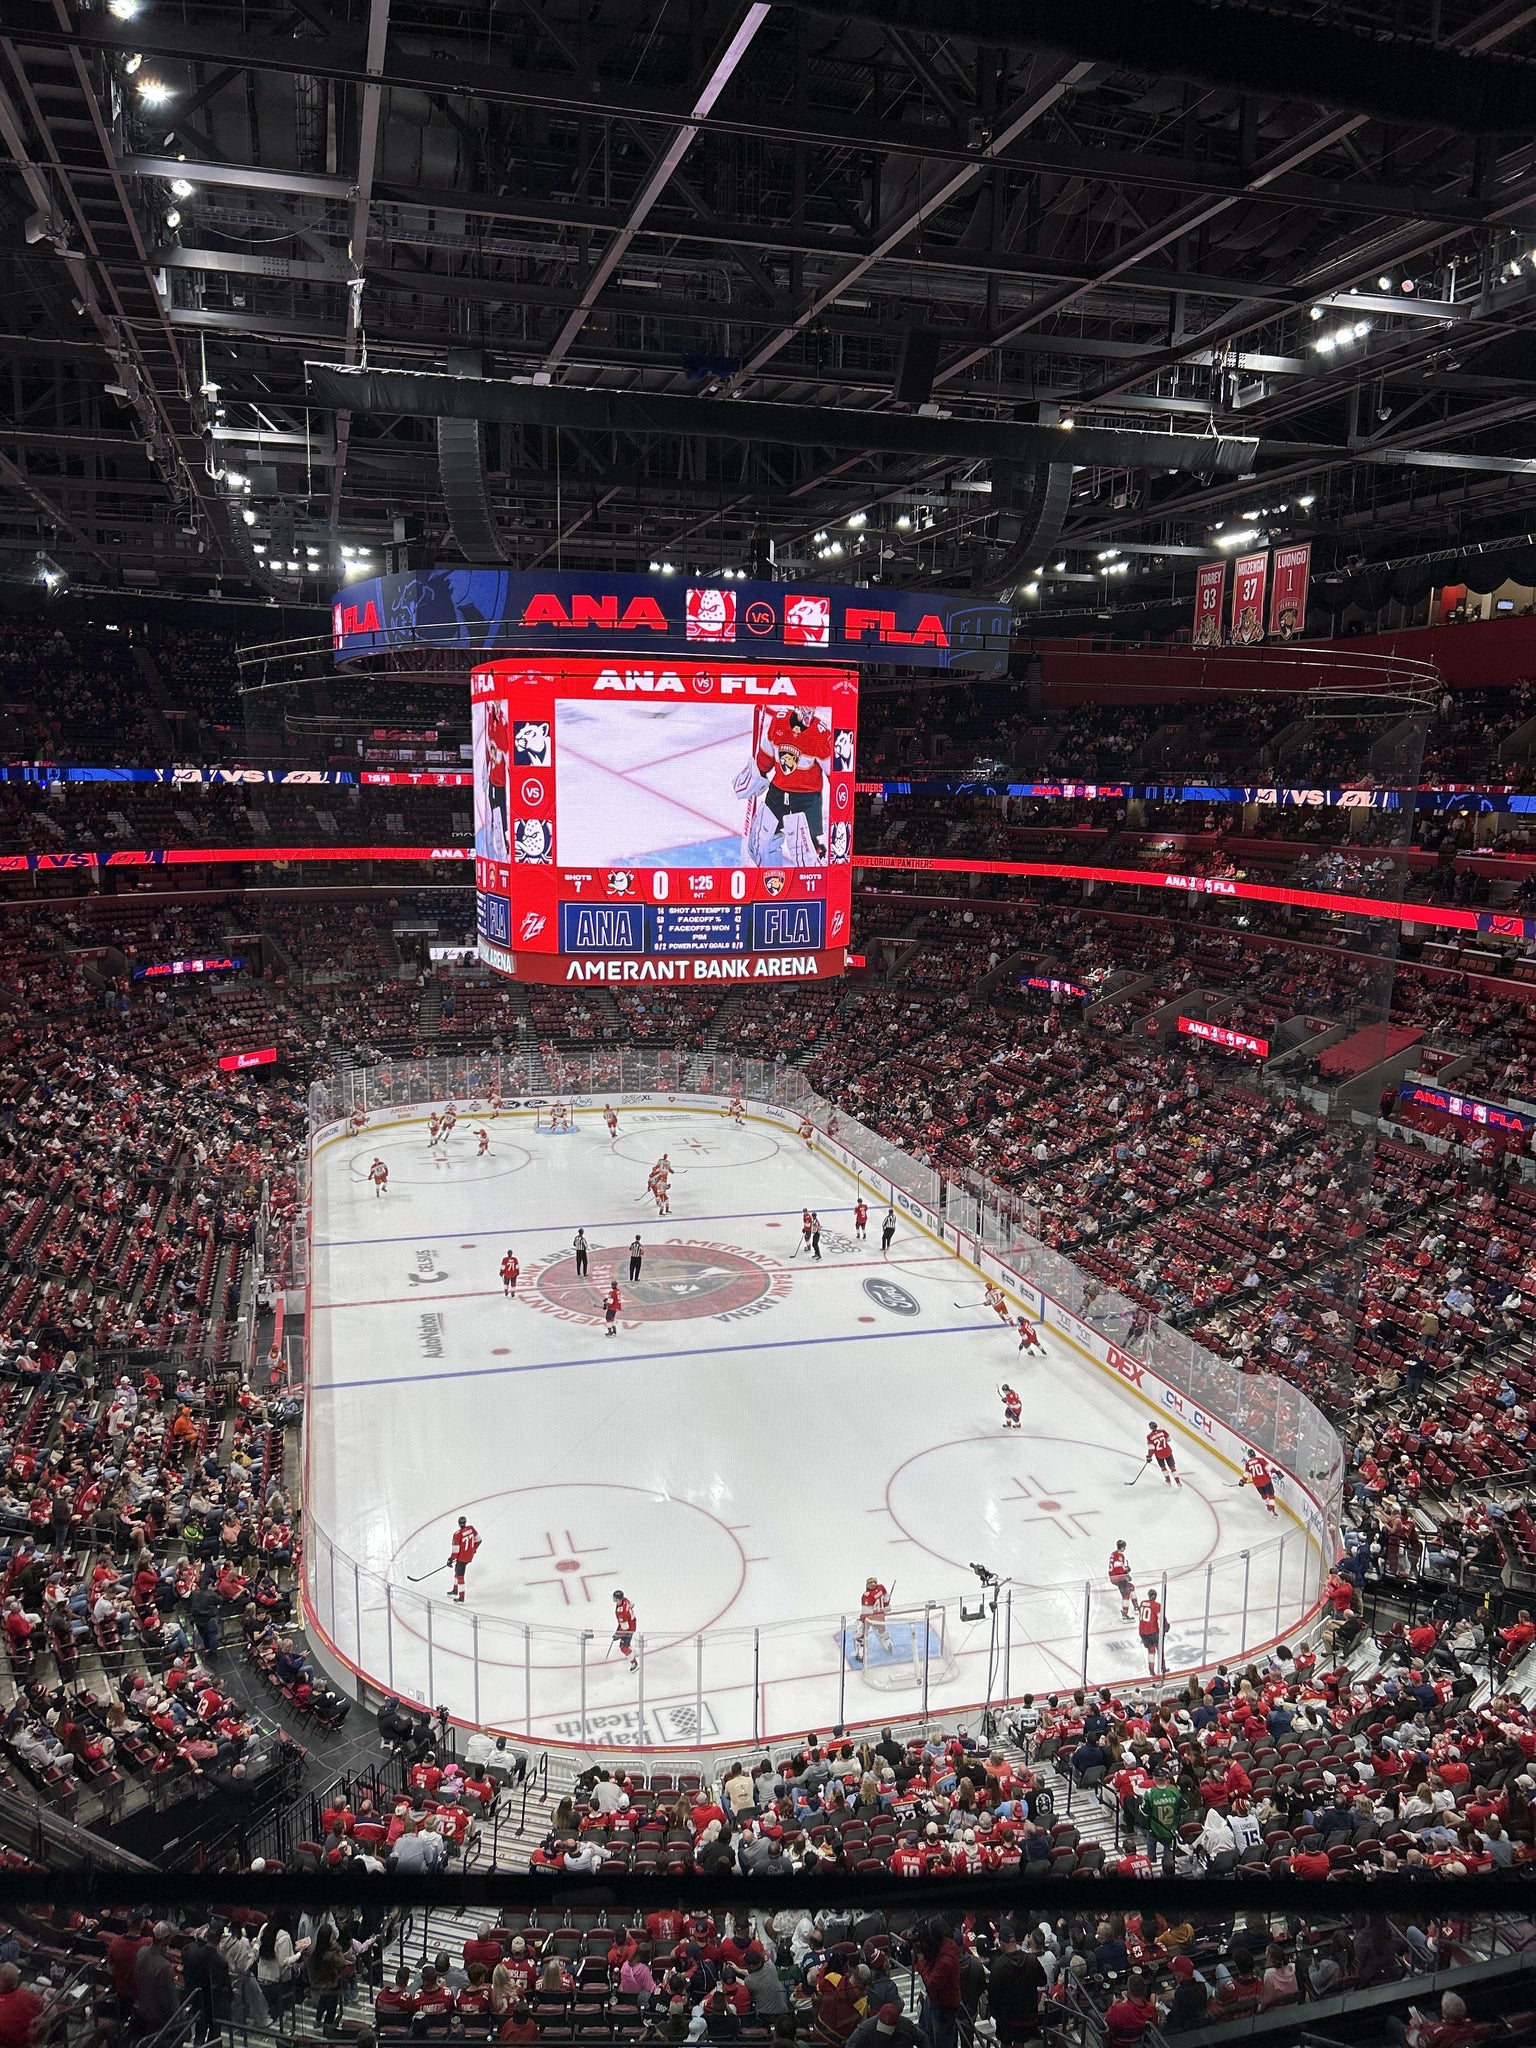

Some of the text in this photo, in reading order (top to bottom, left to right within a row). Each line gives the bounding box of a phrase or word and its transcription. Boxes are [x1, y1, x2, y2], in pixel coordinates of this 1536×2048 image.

[1277, 550, 1306, 569] LUONGO
[1200, 570, 1222, 587] TORREY
[1286, 569, 1293, 592] 1
[1243, 577, 1258, 601] 37
[1203, 588, 1217, 610] 93
[343, 601, 380, 638] FLA
[519, 594, 668, 630] ANA
[844, 608, 950, 647] FLA
[478, 673, 495, 693] FLA
[593, 669, 798, 696] ANA VS FLA
[222, 769, 265, 783] VS
[525, 787, 540, 798] VS
[838, 792, 847, 802] VS
[1032, 785, 1124, 797] ANA FLA
[1291, 789, 1324, 806] VS
[50, 852, 90, 867] VS
[430, 849, 464, 858] ANA
[866, 857, 895, 867] FLORIDA
[897, 858, 935, 869] PANTHERS
[574, 881, 581, 893] 7
[652, 870, 669, 900] 0
[688, 875, 714, 891] 1:25
[731, 870, 746, 900] 0
[806, 880, 816, 892] 11
[1165, 875, 1236, 894] ANA FLA
[576, 910, 633, 946] ANA
[658, 925, 663, 933] 7
[764, 909, 811, 944] FLA
[145, 966, 172, 976] ANA
[205, 959, 232, 969] FLA
[566, 956, 819, 980] AMERANT BANK ARENA
[1028, 977, 1049, 989] ANA
[1188, 1022, 1258, 1051] ANA FLA
[390, 1105, 419, 1114] AMERANT
[397, 1111, 413, 1120] BANK
[1413, 1089, 1524, 1132] ANA FLA
[415, 1249, 434, 1273] CELSIUS
[665, 1237, 783, 1267] AMERANT
[506, 1262, 515, 1272] 71
[516, 1243, 607, 1288] BANK AREA
[711, 1273, 793, 1323] BANK ARENA
[416, 1312, 445, 1360] AutoNation
[1105, 1346, 1146, 1389] DEX
[1165, 1390, 1183, 1413] CH
[1193, 1410, 1212, 1434] CH
[1153, 1438, 1167, 1451] 27
[1248, 1463, 1264, 1478] 70
[461, 1535, 475, 1552] 77
[1140, 1606, 1152, 1623] 10
[1156, 1805, 1175, 1825] 12
[436, 1823, 457, 1836] 42
[1242, 1830, 1259, 1846] 15
